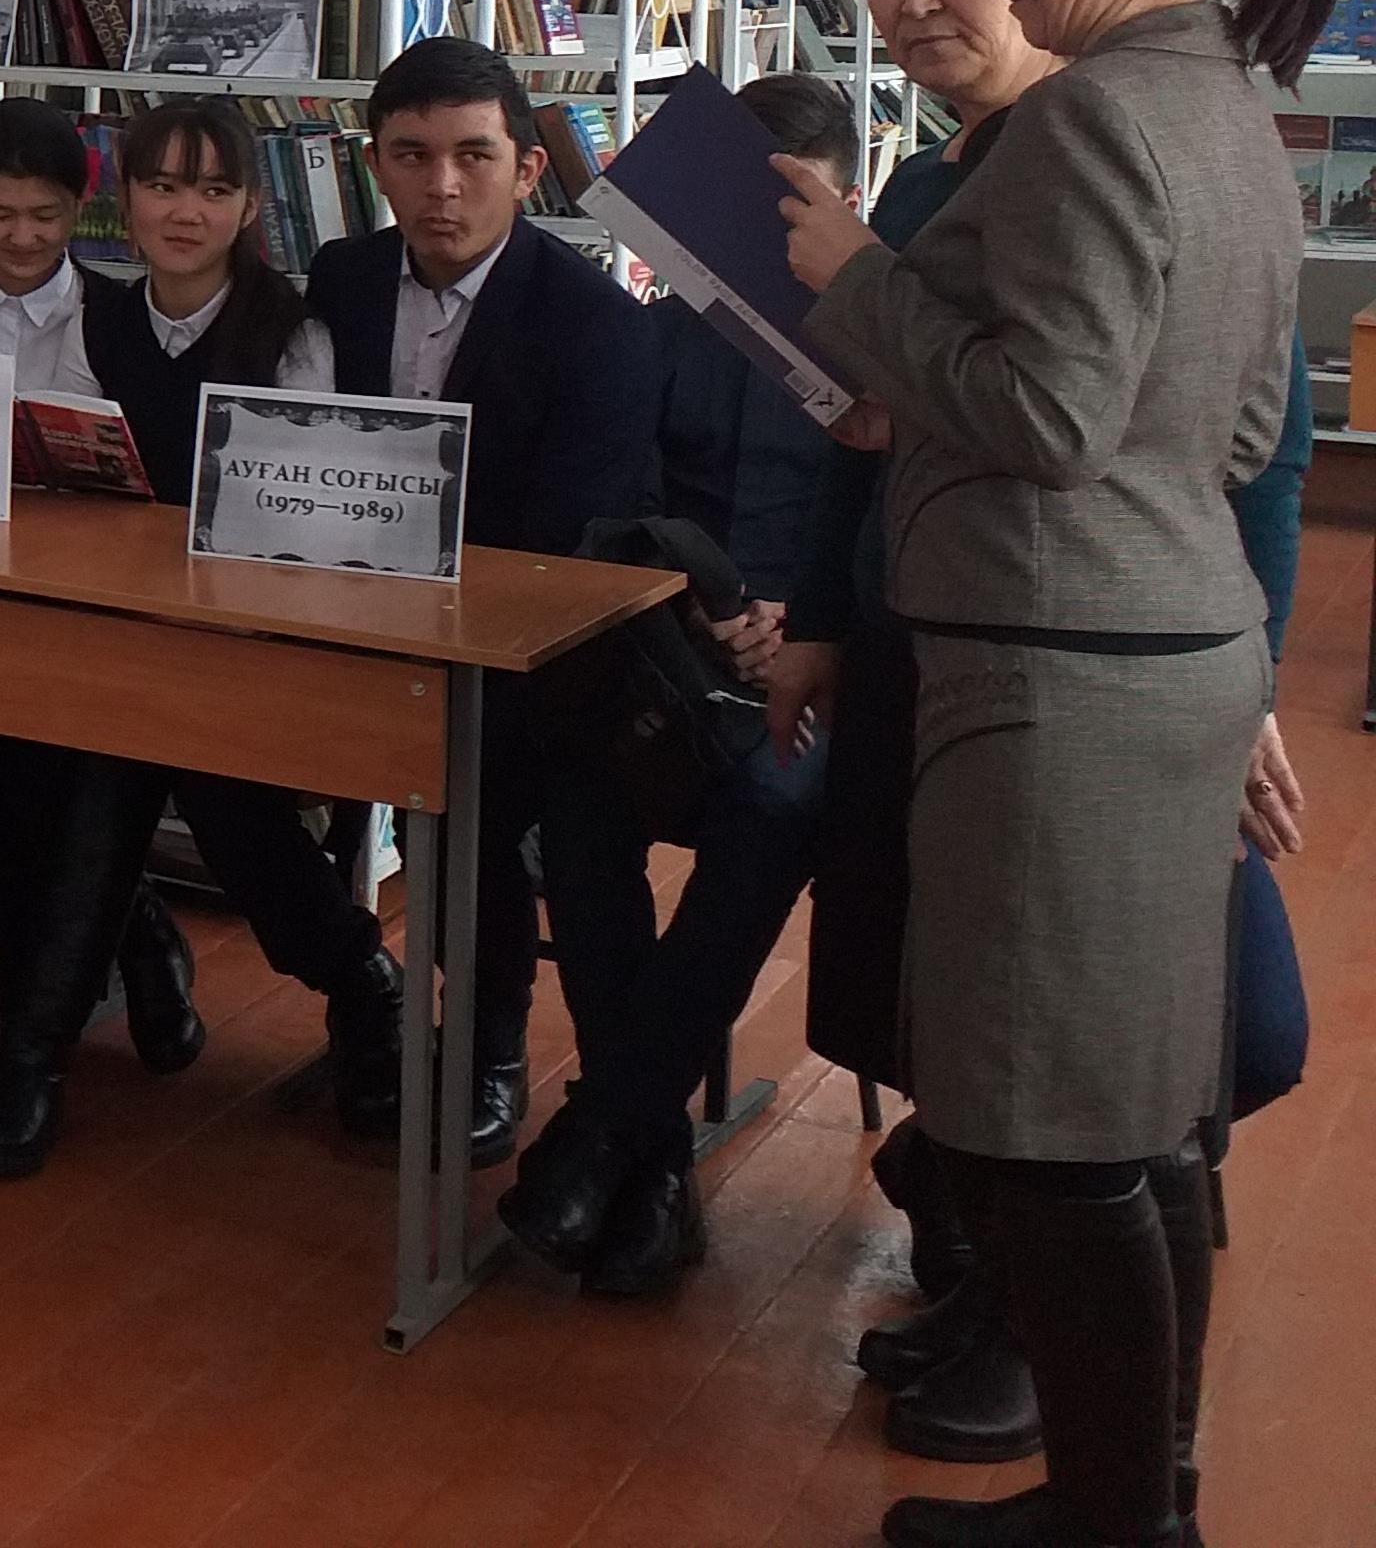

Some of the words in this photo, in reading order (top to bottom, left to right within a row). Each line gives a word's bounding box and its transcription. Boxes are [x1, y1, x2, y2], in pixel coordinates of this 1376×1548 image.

[306, 147, 325, 169] Б
[224, 459, 312, 484] АУҒАН
[320, 467, 442, 496] СОҒЫСЫ
